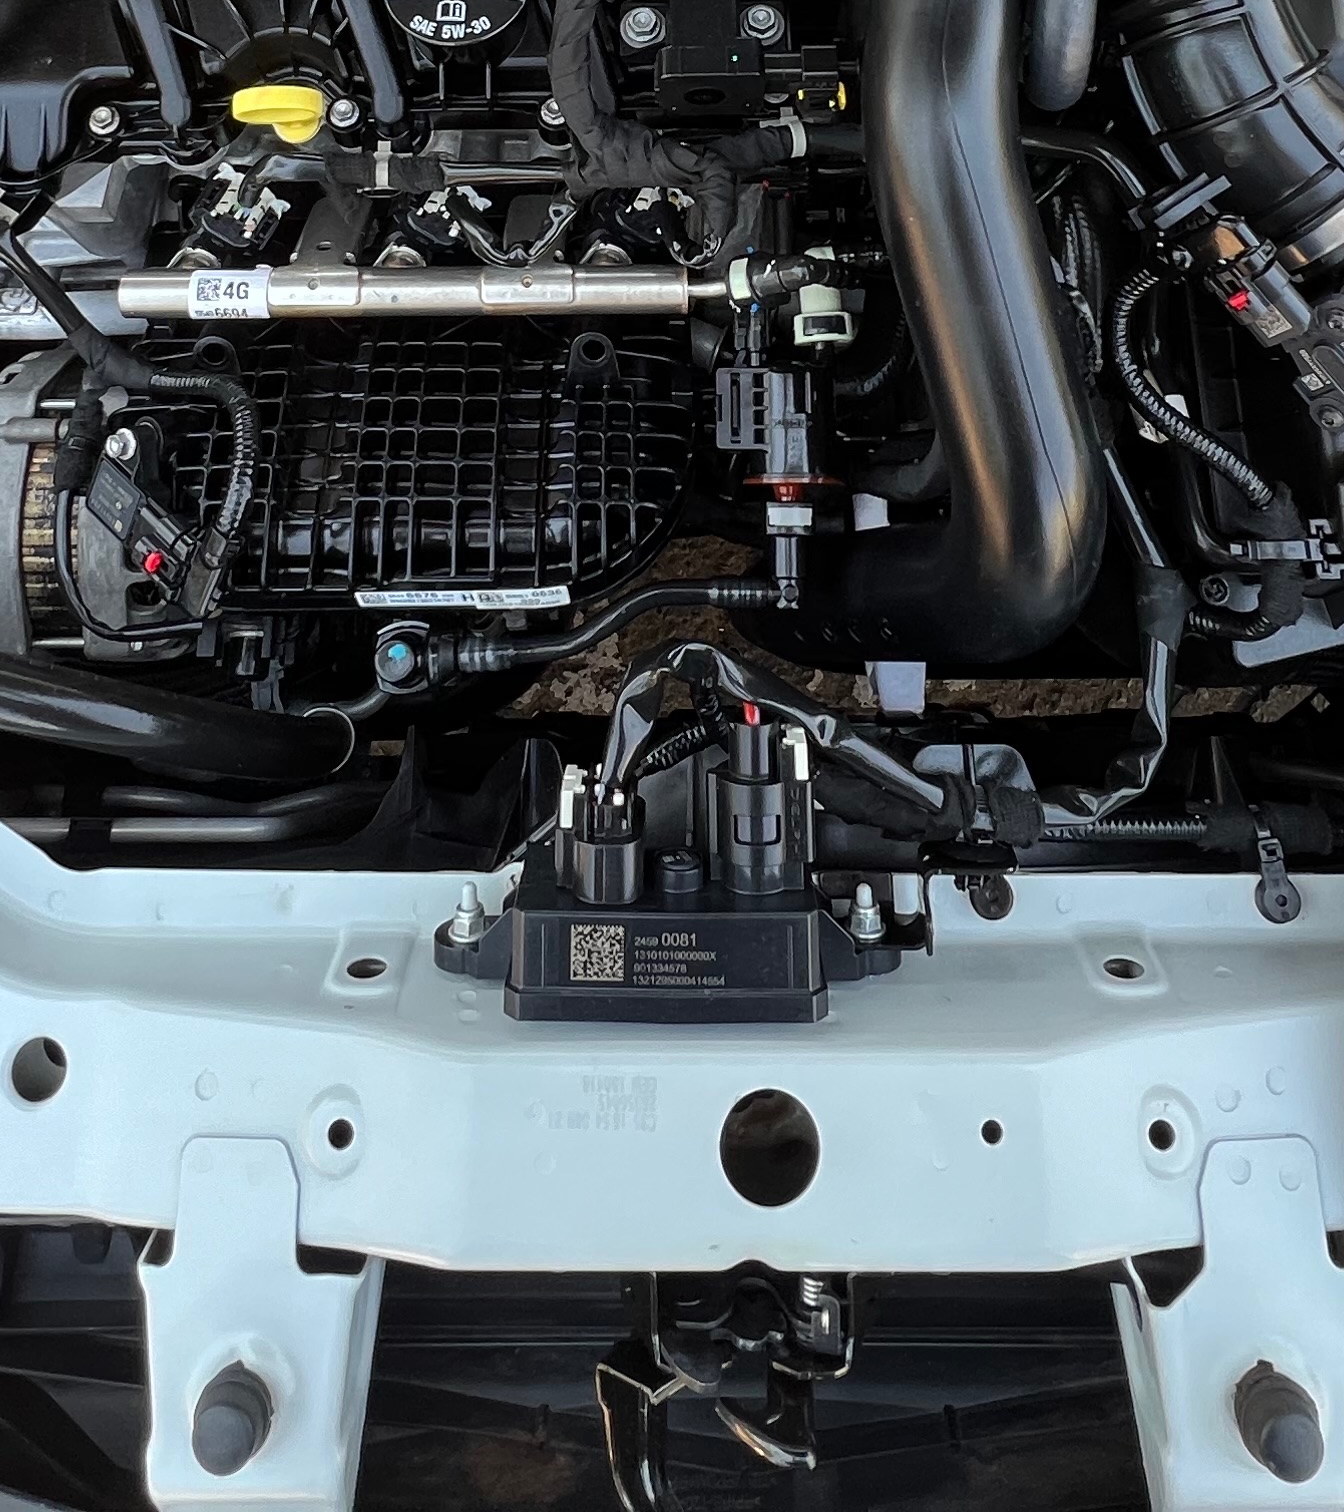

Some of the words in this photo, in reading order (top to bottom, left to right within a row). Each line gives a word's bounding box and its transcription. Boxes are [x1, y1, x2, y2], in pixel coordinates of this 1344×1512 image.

[409, 15, 437, 37] SAE
[441, 15, 492, 39] 5W-30
[222, 281, 250, 300] 4G
[461, 593, 475, 602] H
[661, 932, 697, 947] 0081
